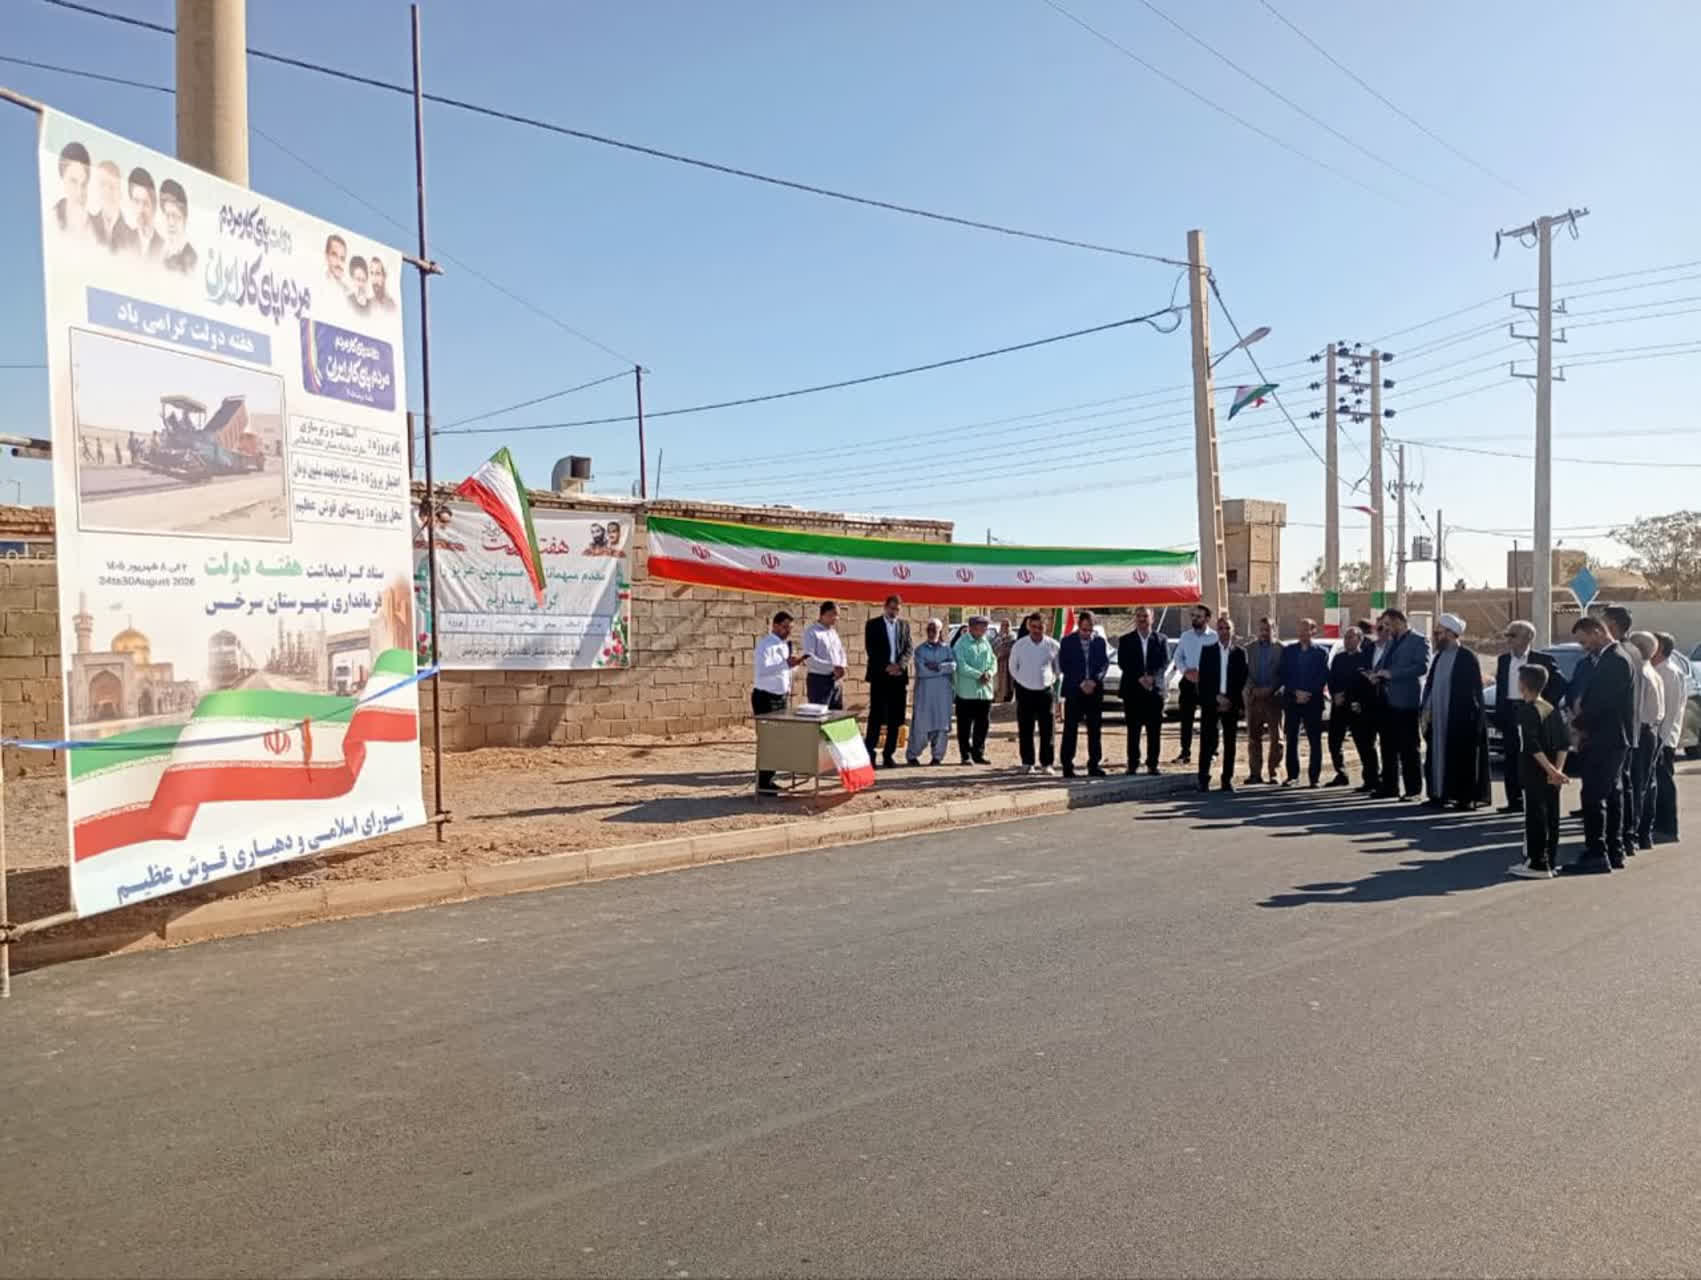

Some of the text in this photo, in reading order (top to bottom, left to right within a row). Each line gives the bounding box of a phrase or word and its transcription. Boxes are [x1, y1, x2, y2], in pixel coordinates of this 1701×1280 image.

[205, 247, 312, 326] مردم پای کار ایران
[142, 313, 188, 341] گرامی
[190, 324, 225, 351] دولت
[227, 332, 255, 353] هفته
[204, 551, 251, 583] دولت
[256, 554, 304, 577] هفته
[306, 563, 365, 583] گرامیداشت
[205, 591, 382, 616] فرمانداری شهرستان سرخس
[115, 804, 404, 905] شورای اسلامی و دهیاری قوش عظیم
